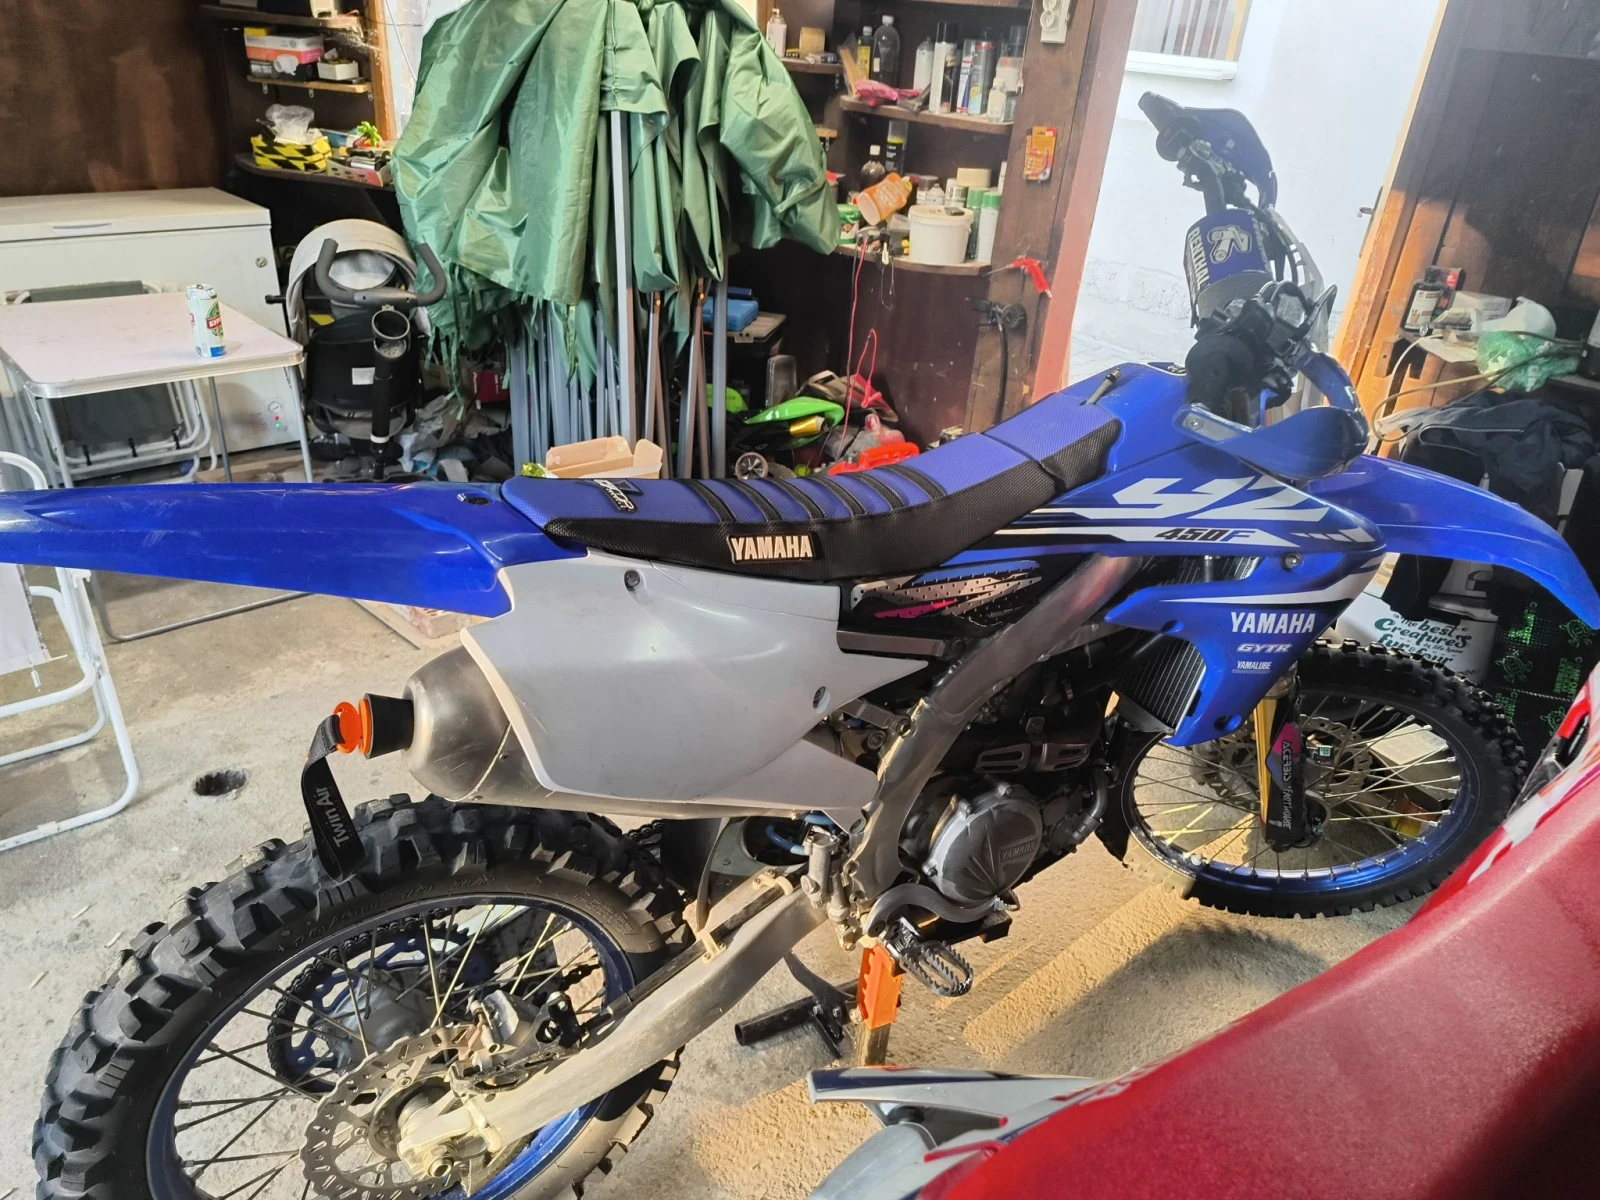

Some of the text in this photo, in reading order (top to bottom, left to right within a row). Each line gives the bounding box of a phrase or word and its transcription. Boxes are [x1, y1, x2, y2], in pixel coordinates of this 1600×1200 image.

[1189, 226, 1211, 292] RENTHAL
[1154, 527, 1256, 543] 450F
[731, 535, 813, 561] YAMAHA
[1230, 611, 1316, 635] YAMAHA
[1418, 619, 1457, 638] best
[1236, 642, 1293, 654] GYTR
[1236, 660, 1272, 671] YAMALUBE
[312, 786, 349, 848] Twin Air
[1002, 842, 1035, 860] YAMAHA
